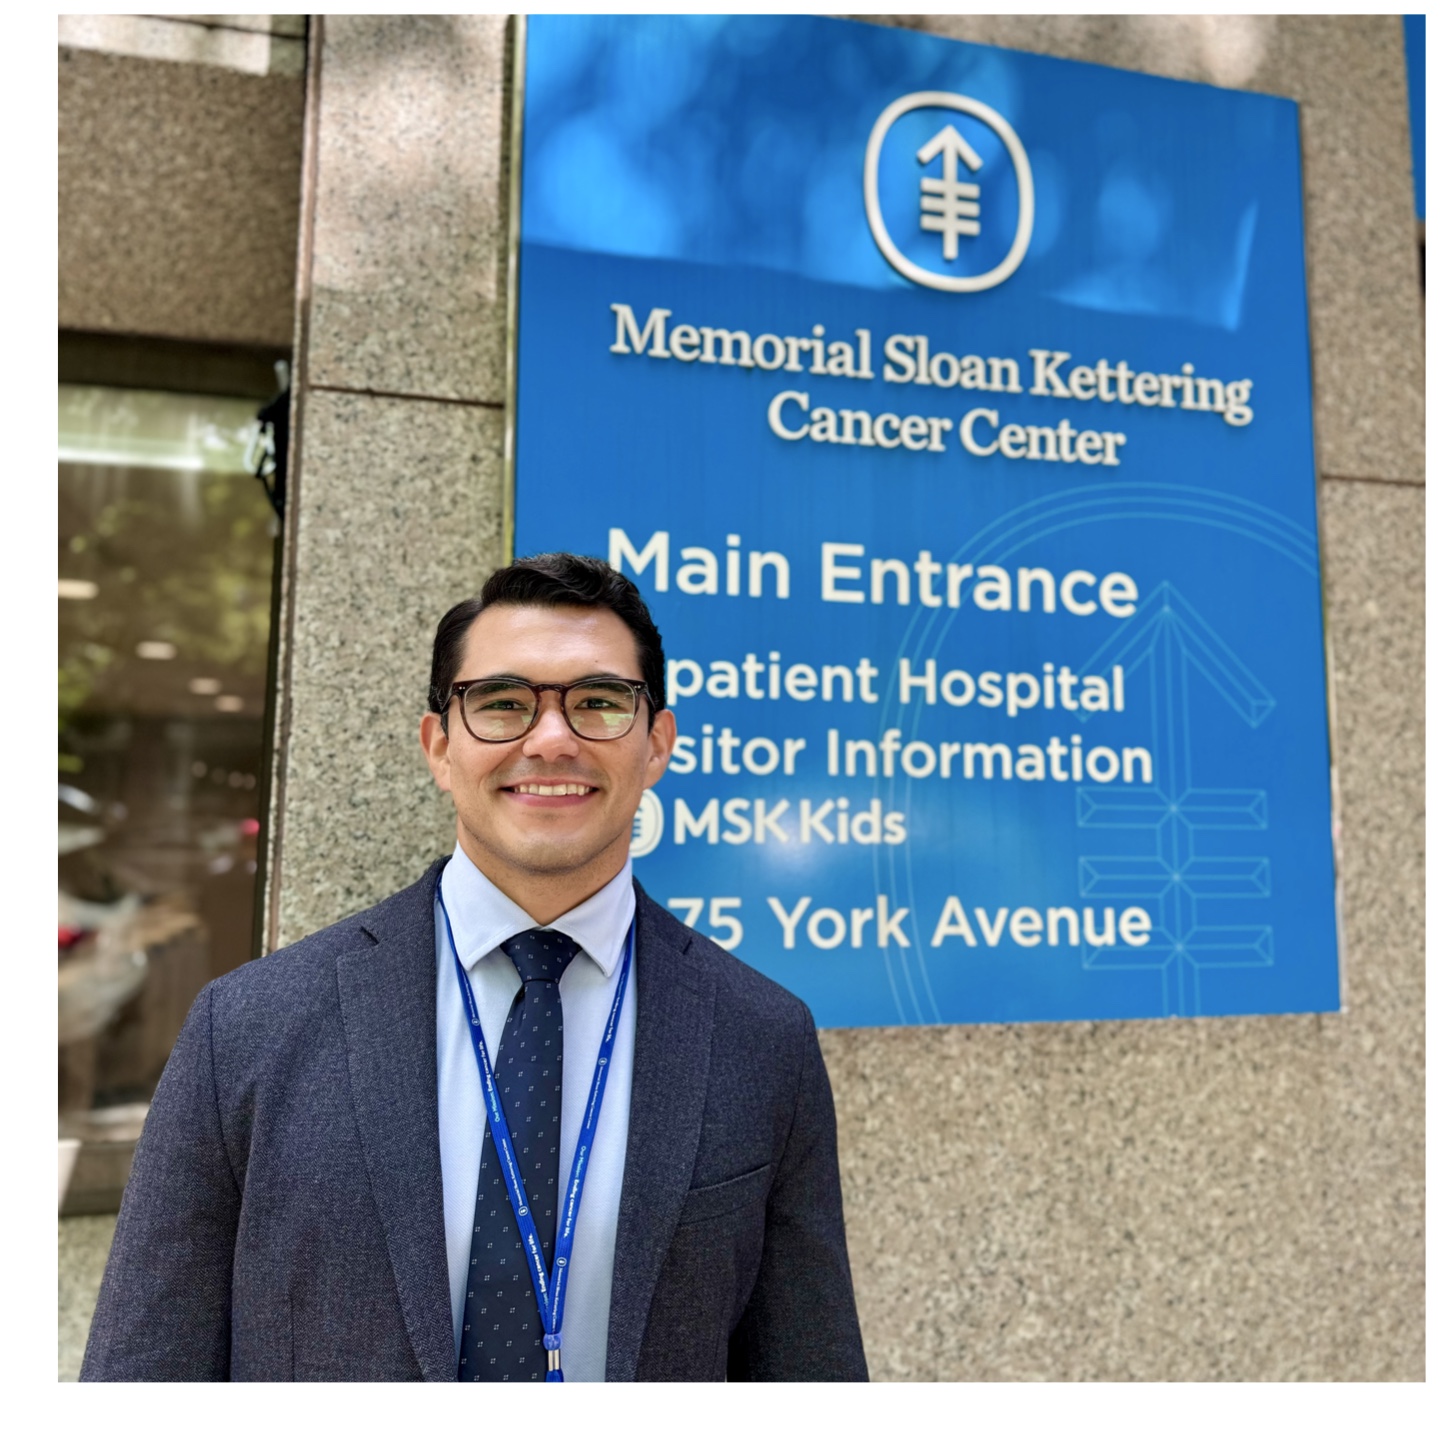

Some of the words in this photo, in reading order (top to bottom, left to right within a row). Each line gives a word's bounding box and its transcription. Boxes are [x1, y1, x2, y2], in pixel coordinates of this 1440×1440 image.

[610, 303, 874, 380] Memorial
[883, 334, 1021, 394] Sloan
[1028, 348, 1253, 426] Kettering
[768, 391, 952, 451] Cancer
[959, 408, 1126, 466] Center
[607, 527, 790, 599] Main
[821, 542, 1138, 618] Entrance
[666, 651, 879, 706] patient
[899, 658, 1124, 717] Hospital
[668, 724, 806, 776] sitor
[827, 728, 1153, 783] Information
[667, 897, 744, 951] 75
[767, 895, 910, 949] York
[931, 895, 1152, 948] Avenue
